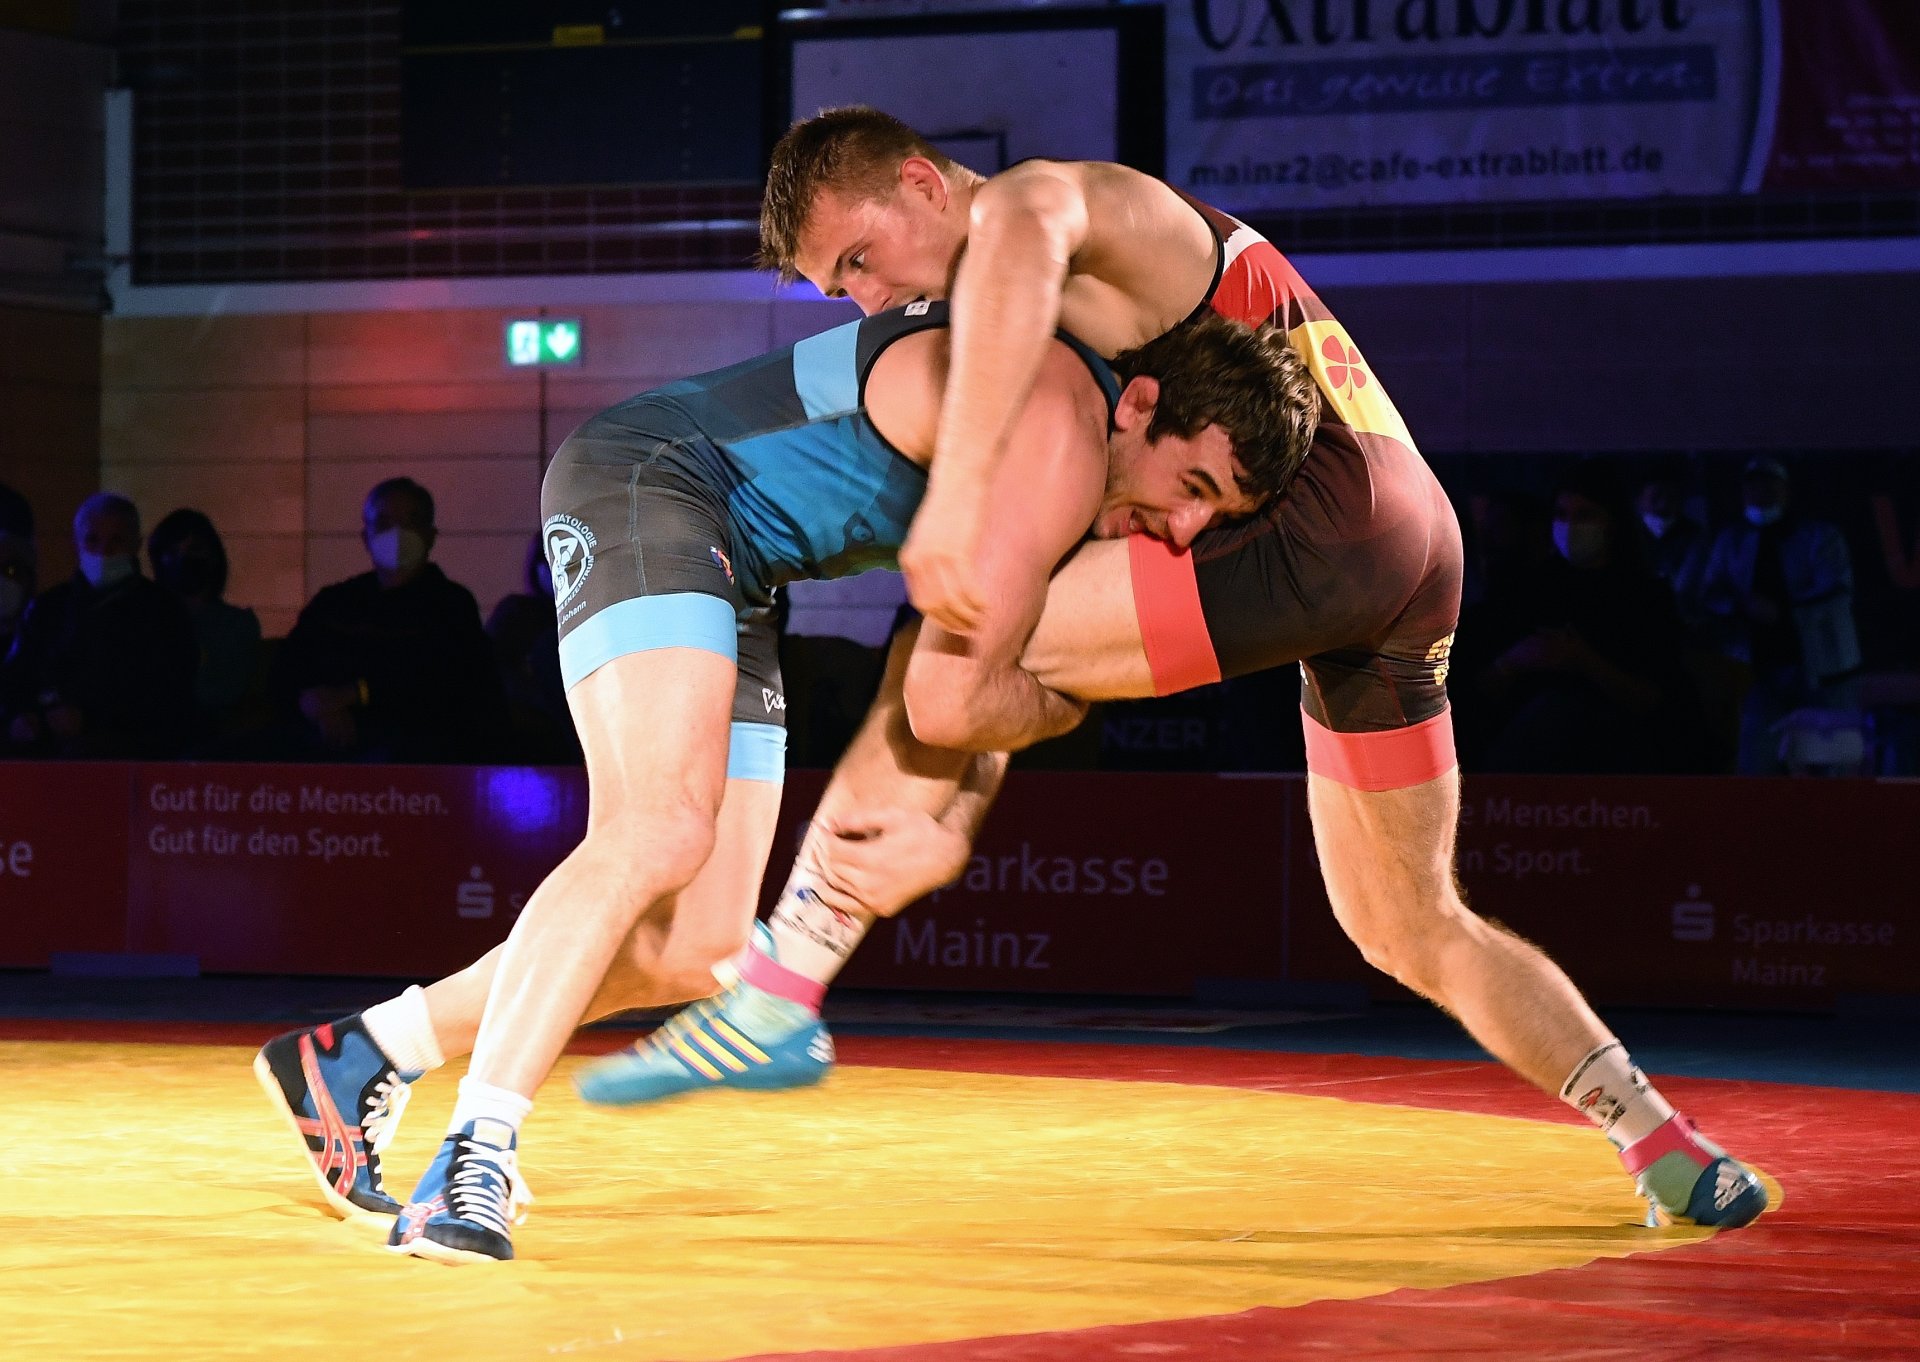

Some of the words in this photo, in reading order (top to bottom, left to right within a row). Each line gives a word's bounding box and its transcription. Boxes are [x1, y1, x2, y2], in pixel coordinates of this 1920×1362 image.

[1190, 146, 1664, 190] mainz2@cafe-extrablatt.de
[561, 600, 587, 625] Johann
[150, 783, 197, 814] Gut
[203, 781, 240, 814] für
[249, 783, 290, 815] die
[299, 785, 450, 818] Menschen.
[1484, 797, 1661, 830] Menschen.
[148, 825, 195, 856] Gut
[201, 825, 239, 856] für
[247, 827, 298, 857] den
[305, 829, 391, 864] Sport.
[1494, 842, 1592, 879] Sport.
[893, 918, 1052, 969] Mainz
[1732, 914, 1896, 946] Sparkasse
[1731, 958, 1827, 988] Mainz
